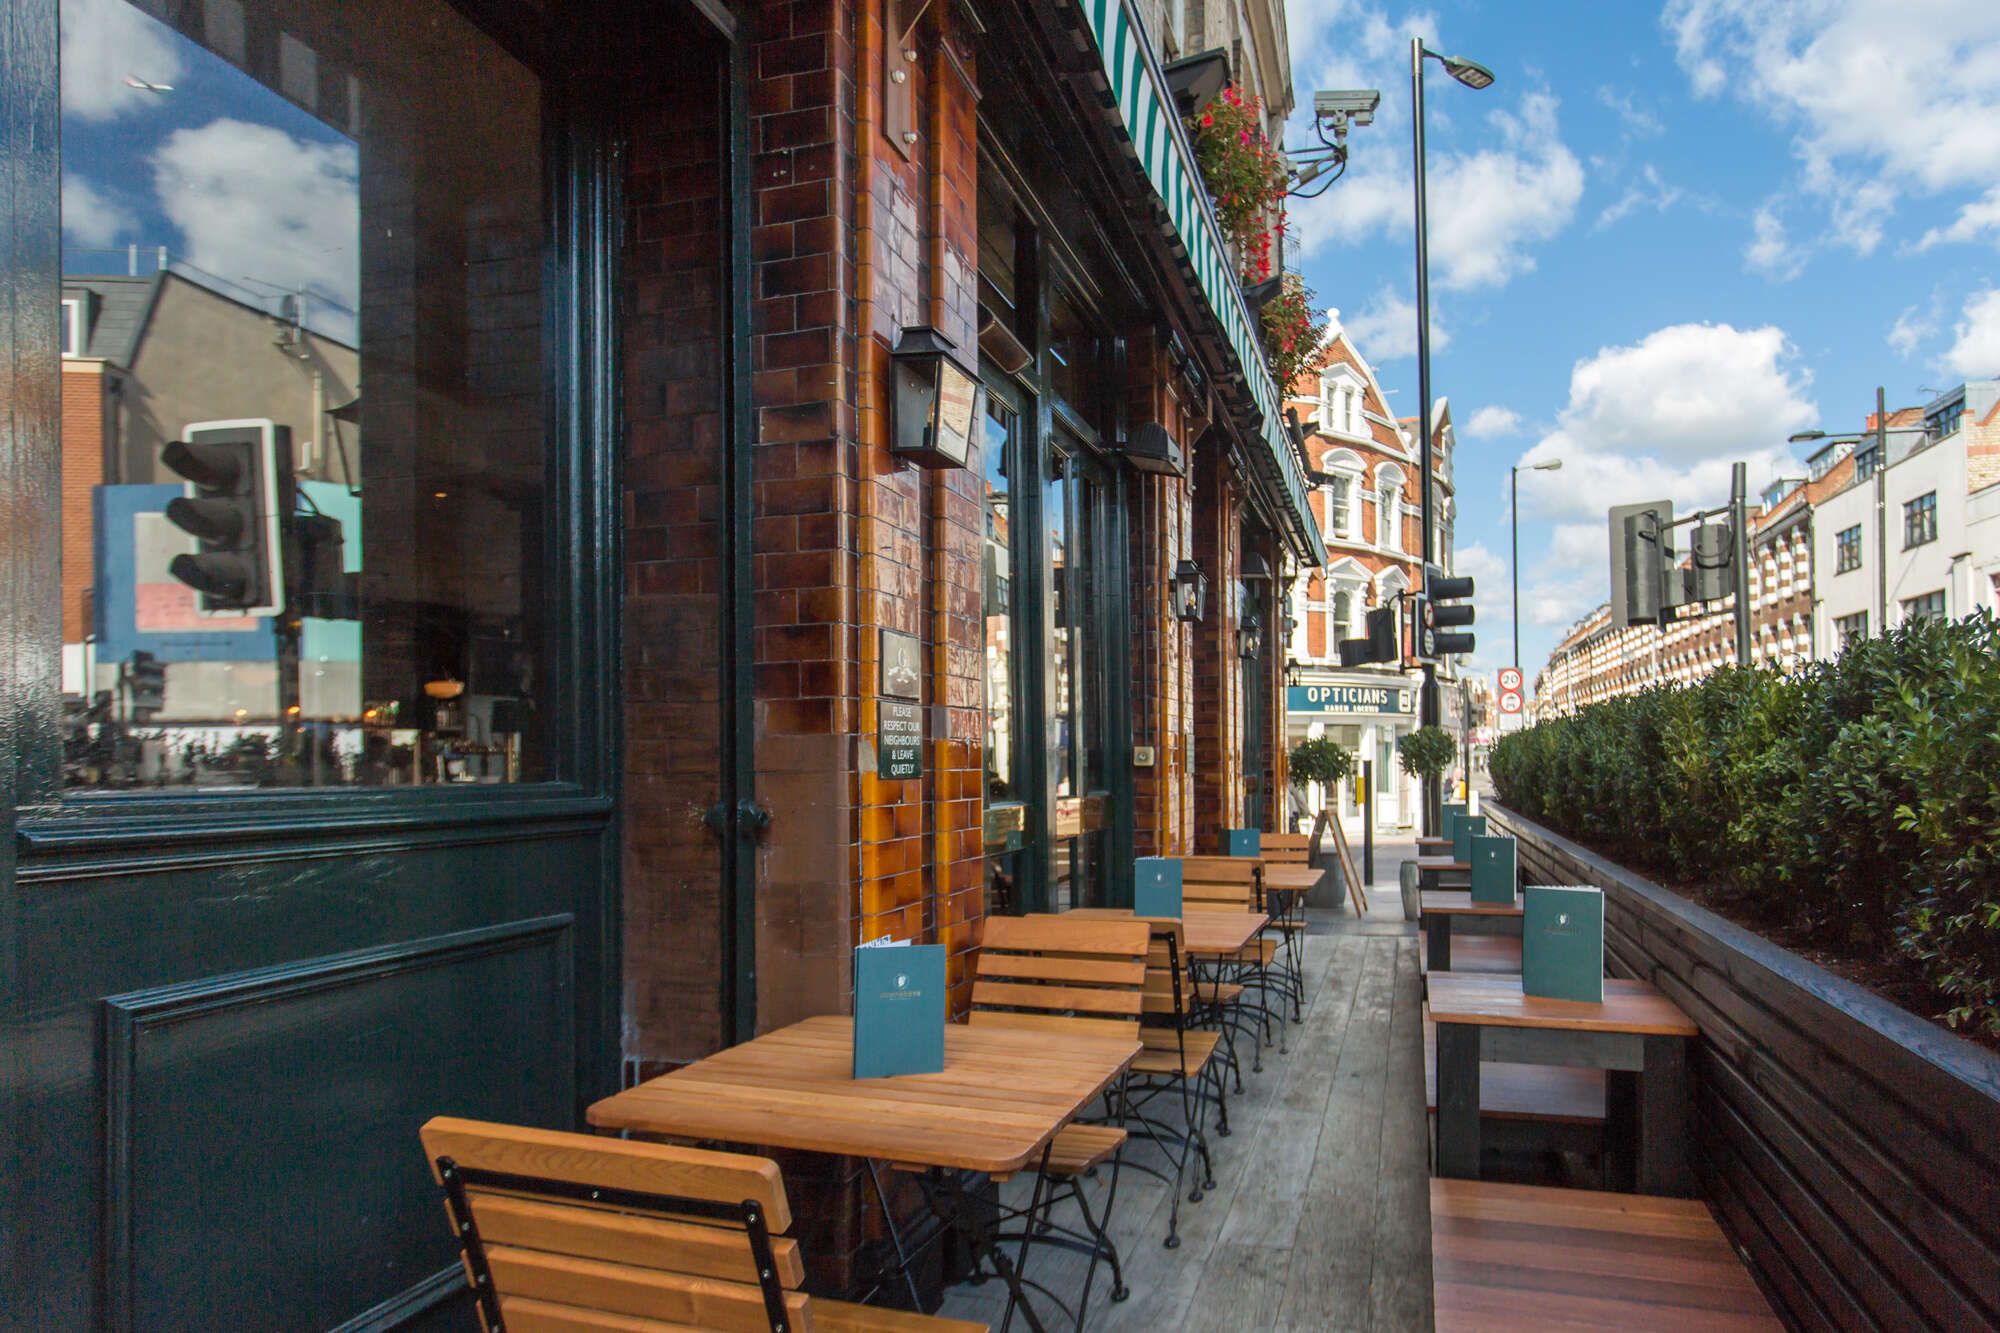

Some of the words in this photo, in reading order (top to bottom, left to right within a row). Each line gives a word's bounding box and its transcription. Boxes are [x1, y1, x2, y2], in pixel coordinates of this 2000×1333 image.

[1307, 686, 1388, 705] OPTICIANS
[892, 706, 912, 718] PLEASE
[883, 719, 907, 731] RESPECT
[907, 721, 921, 732] OUR
[883, 735, 921, 746] NEIGHBOURS
[891, 749, 897, 760] &
[897, 749, 914, 760] LEAVE
[890, 763, 915, 776] QUIETLY
